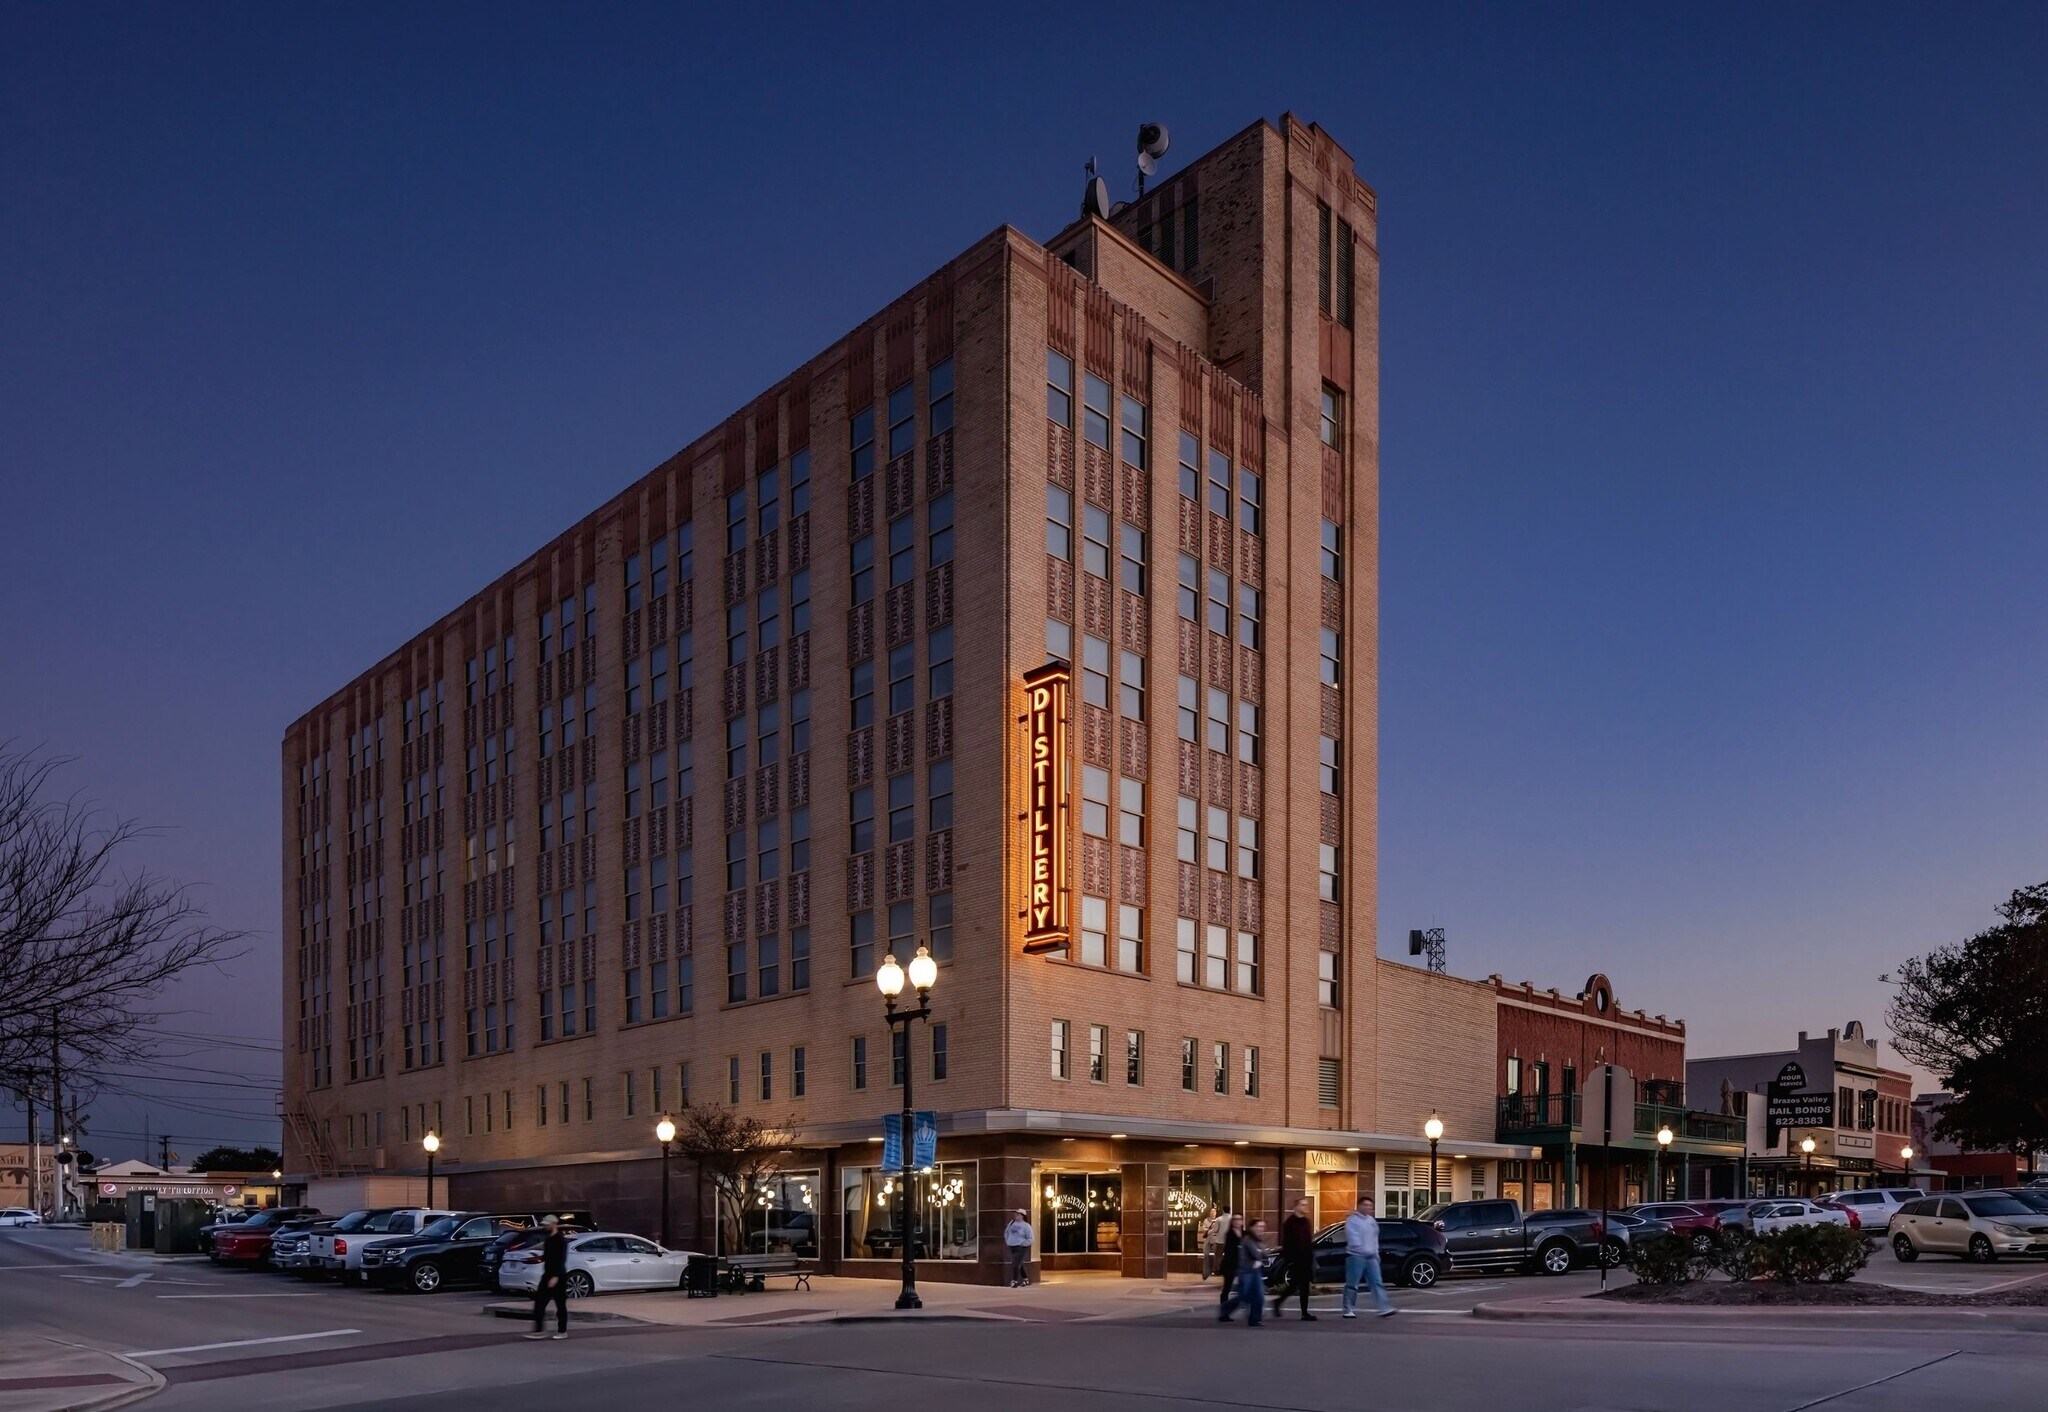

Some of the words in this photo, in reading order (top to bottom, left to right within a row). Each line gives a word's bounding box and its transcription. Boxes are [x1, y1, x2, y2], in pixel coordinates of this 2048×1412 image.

[1033, 687, 1050, 929] DISTILLERY
[1802, 1096, 1828, 1104] Valley
[1769, 1107, 1792, 1115] BAIL
[1795, 1106, 1831, 1114] BONDS
[1775, 1117, 1824, 1125] 822-8383
